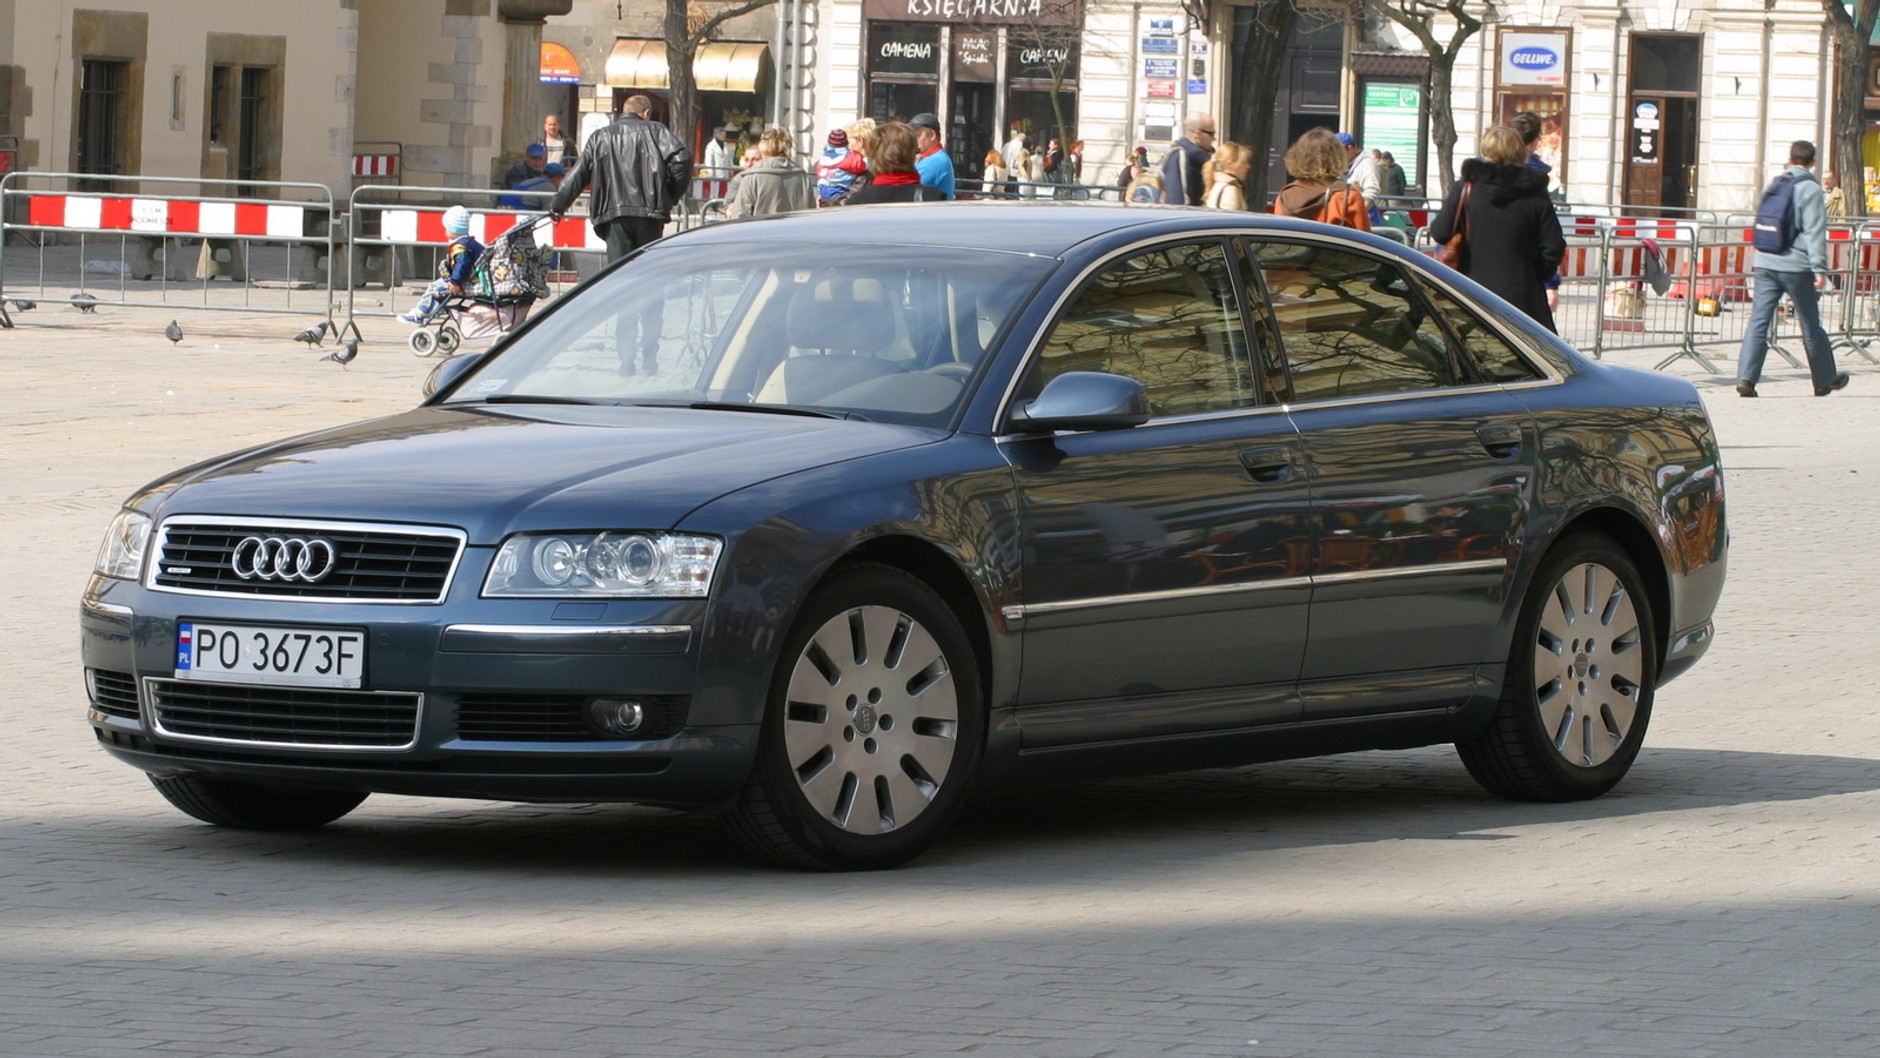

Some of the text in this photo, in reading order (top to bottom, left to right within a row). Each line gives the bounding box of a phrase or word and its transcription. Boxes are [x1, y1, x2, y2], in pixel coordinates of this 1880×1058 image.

[881, 41, 931, 59] CAMENA
[1512, 52, 1554, 65] GELLWE
[179, 652, 190, 663] PL
[196, 629, 358, 675] PO 3673F
